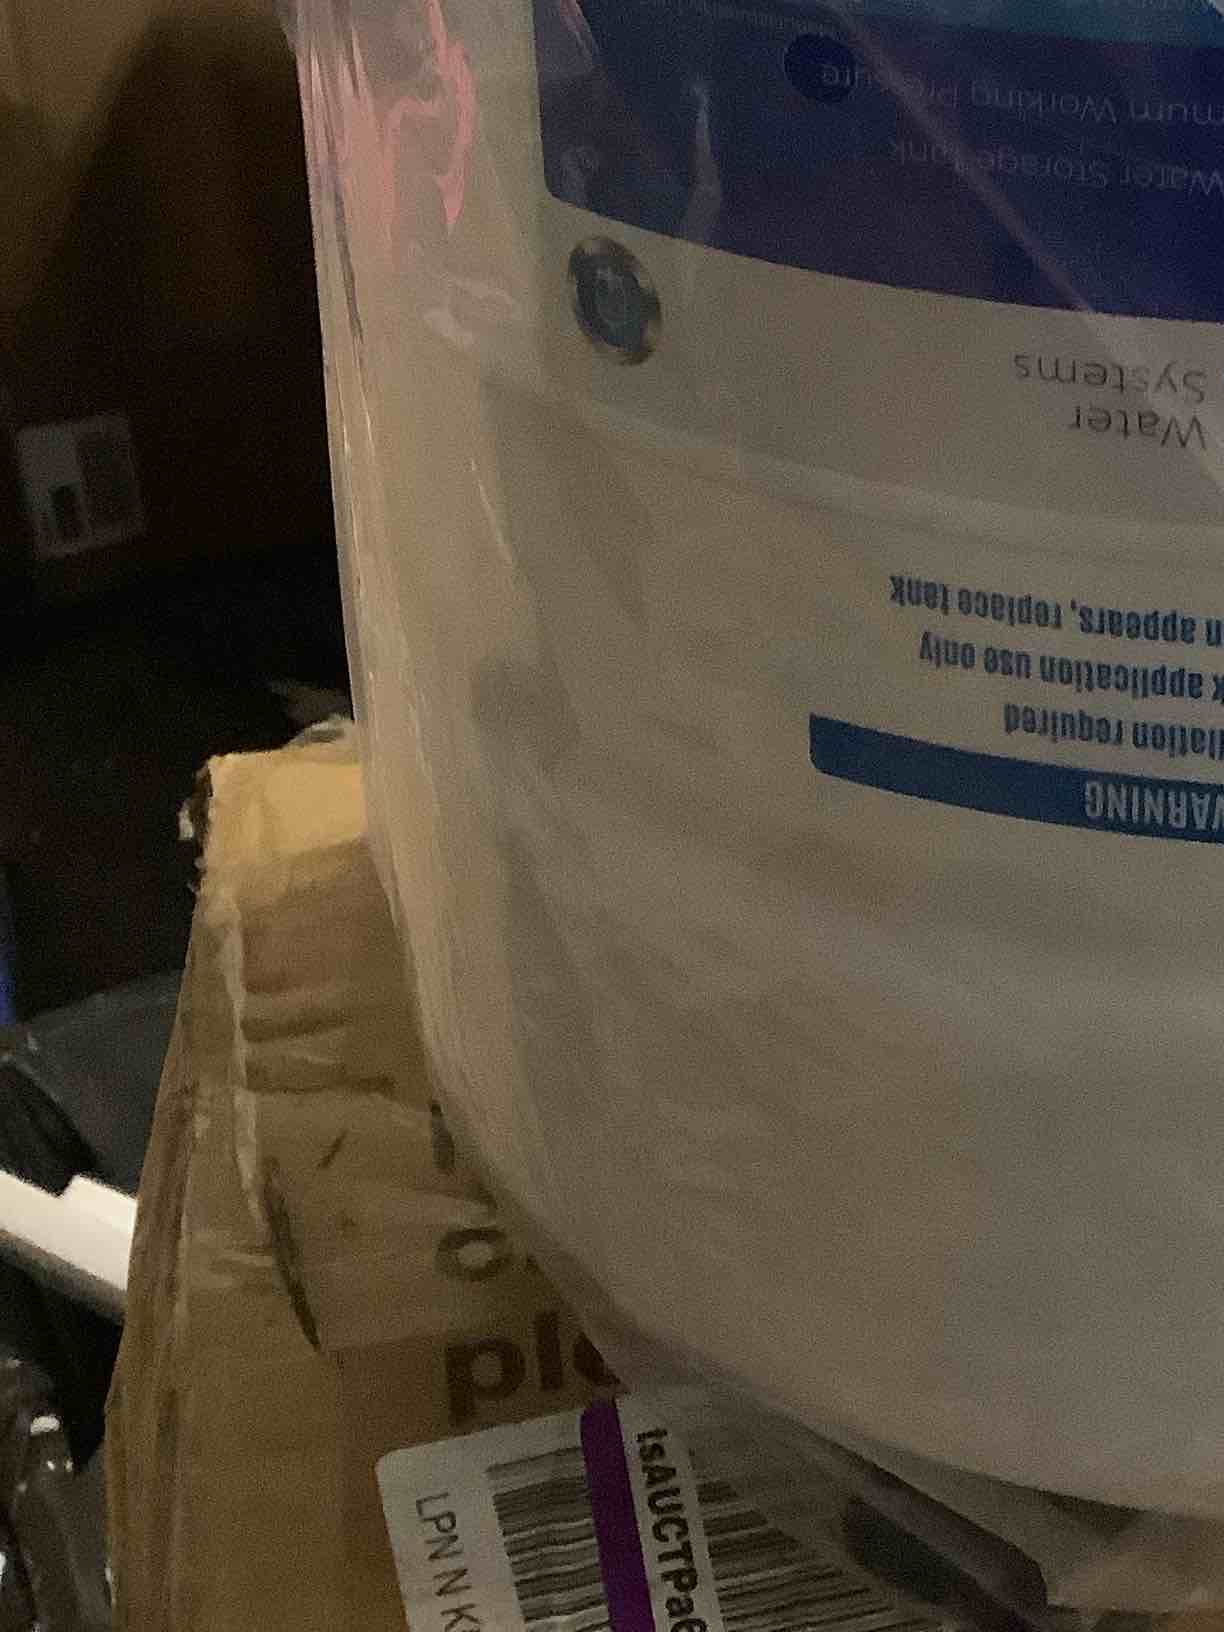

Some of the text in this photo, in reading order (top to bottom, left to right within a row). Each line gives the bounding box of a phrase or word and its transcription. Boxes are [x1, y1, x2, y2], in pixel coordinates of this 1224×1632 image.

[970, 79, 1117, 125] Working
[975, 145, 1110, 191] Storage
[1011, 352, 1208, 403] Systems
[1065, 403, 1208, 452] Water
[888, 574, 951, 615] tank
[956, 587, 1063, 632] replace
[1068, 600, 1197, 648] appears,
[919, 631, 977, 672] only
[982, 649, 1032, 685] use
[1039, 654, 1204, 703] application
[1003, 704, 1124, 748] required
